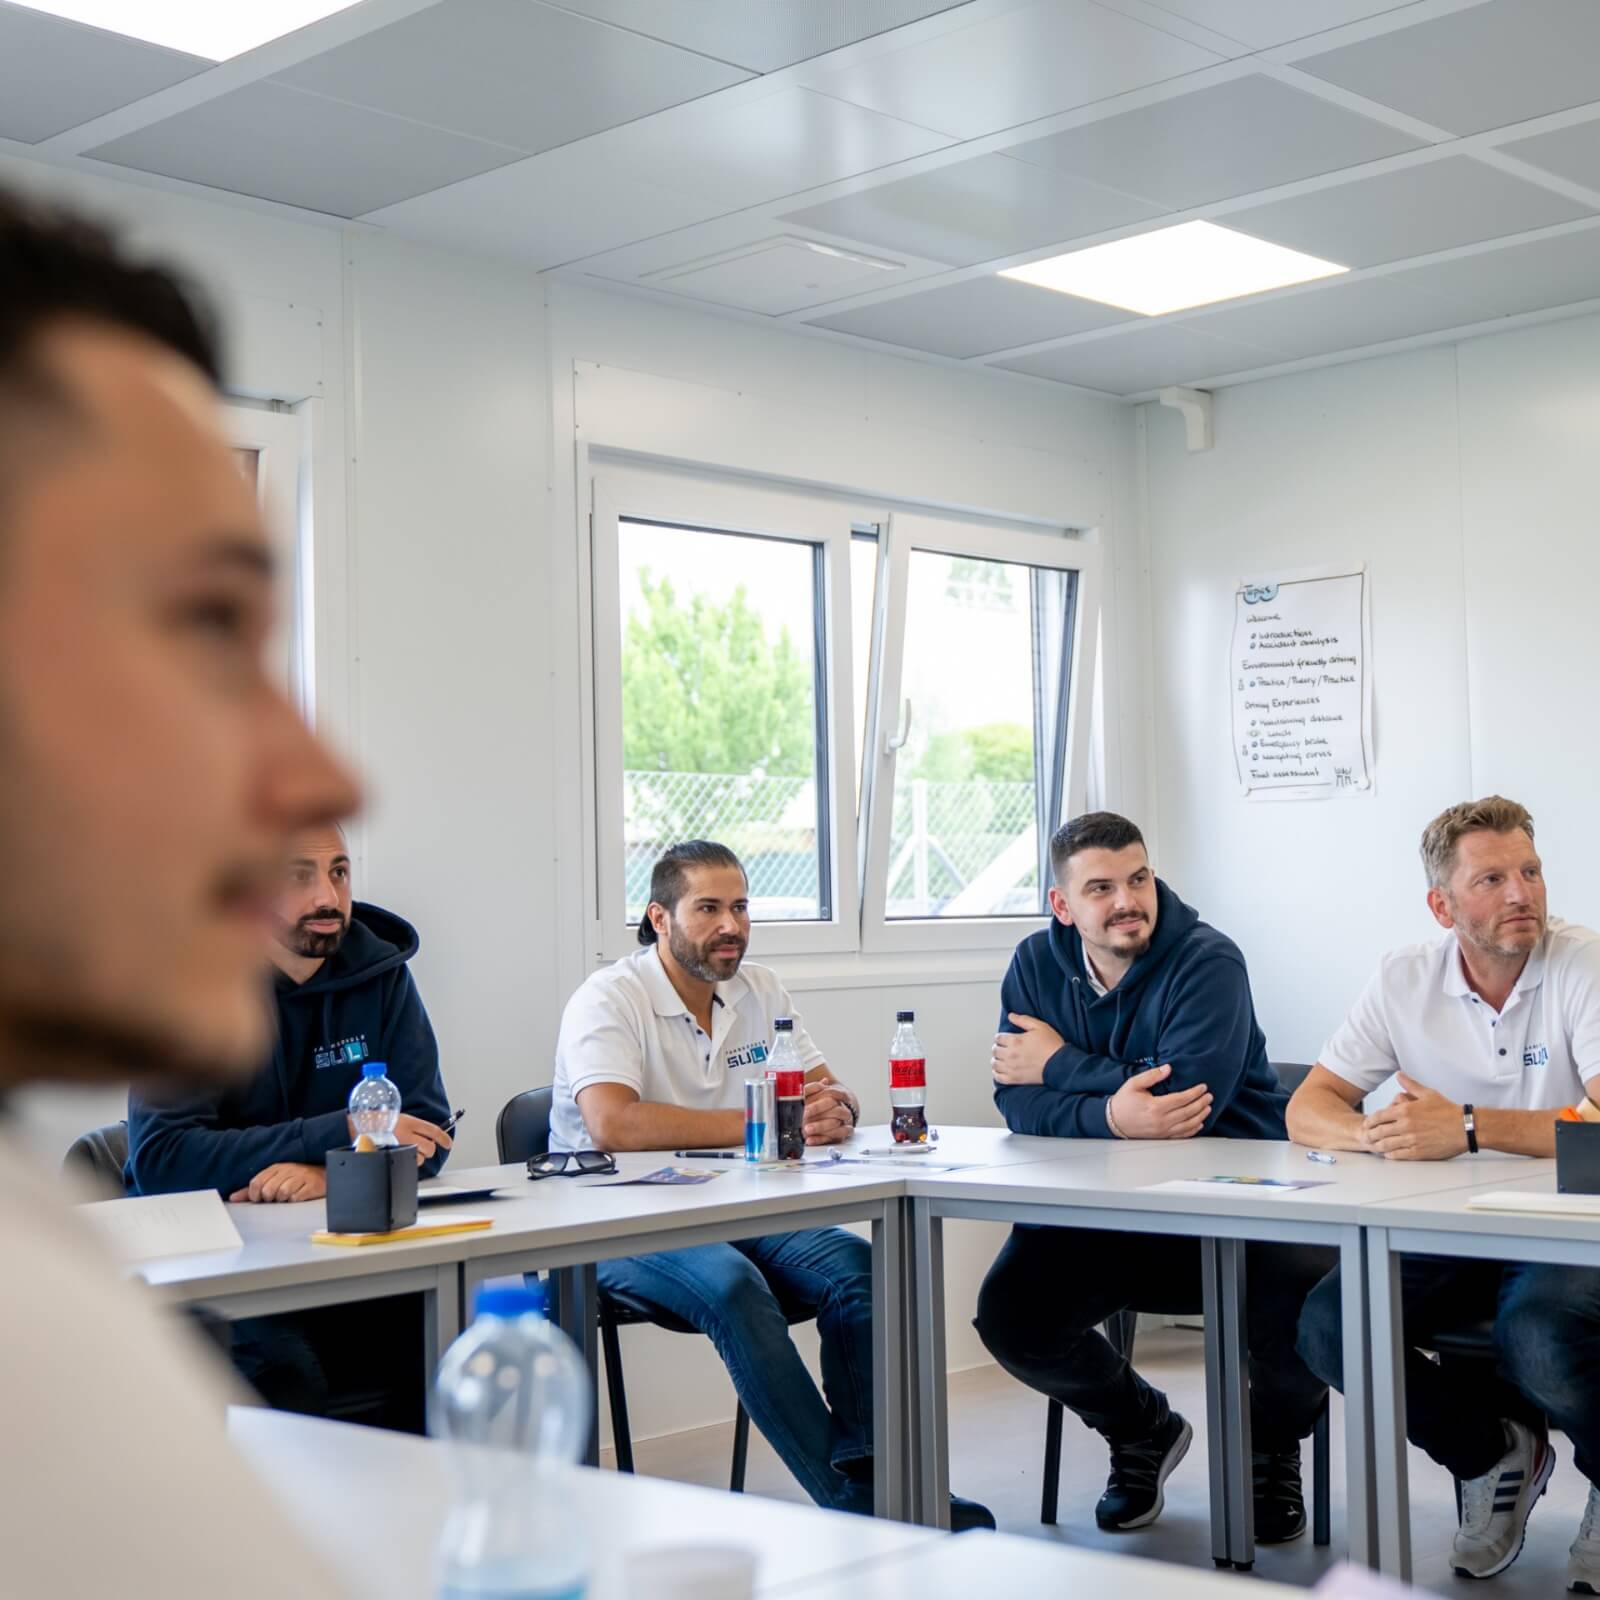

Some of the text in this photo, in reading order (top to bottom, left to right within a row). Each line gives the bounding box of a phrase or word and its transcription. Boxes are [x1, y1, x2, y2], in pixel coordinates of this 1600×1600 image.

[1258, 637, 1339, 649] Accident analysis
[1242, 659, 1295, 670] Environment
[1296, 656, 1327, 670] friendly
[1272, 697, 1320, 709] Experiences
[1306, 751, 1333, 759] curves
[1273, 767, 1320, 778] assessment
